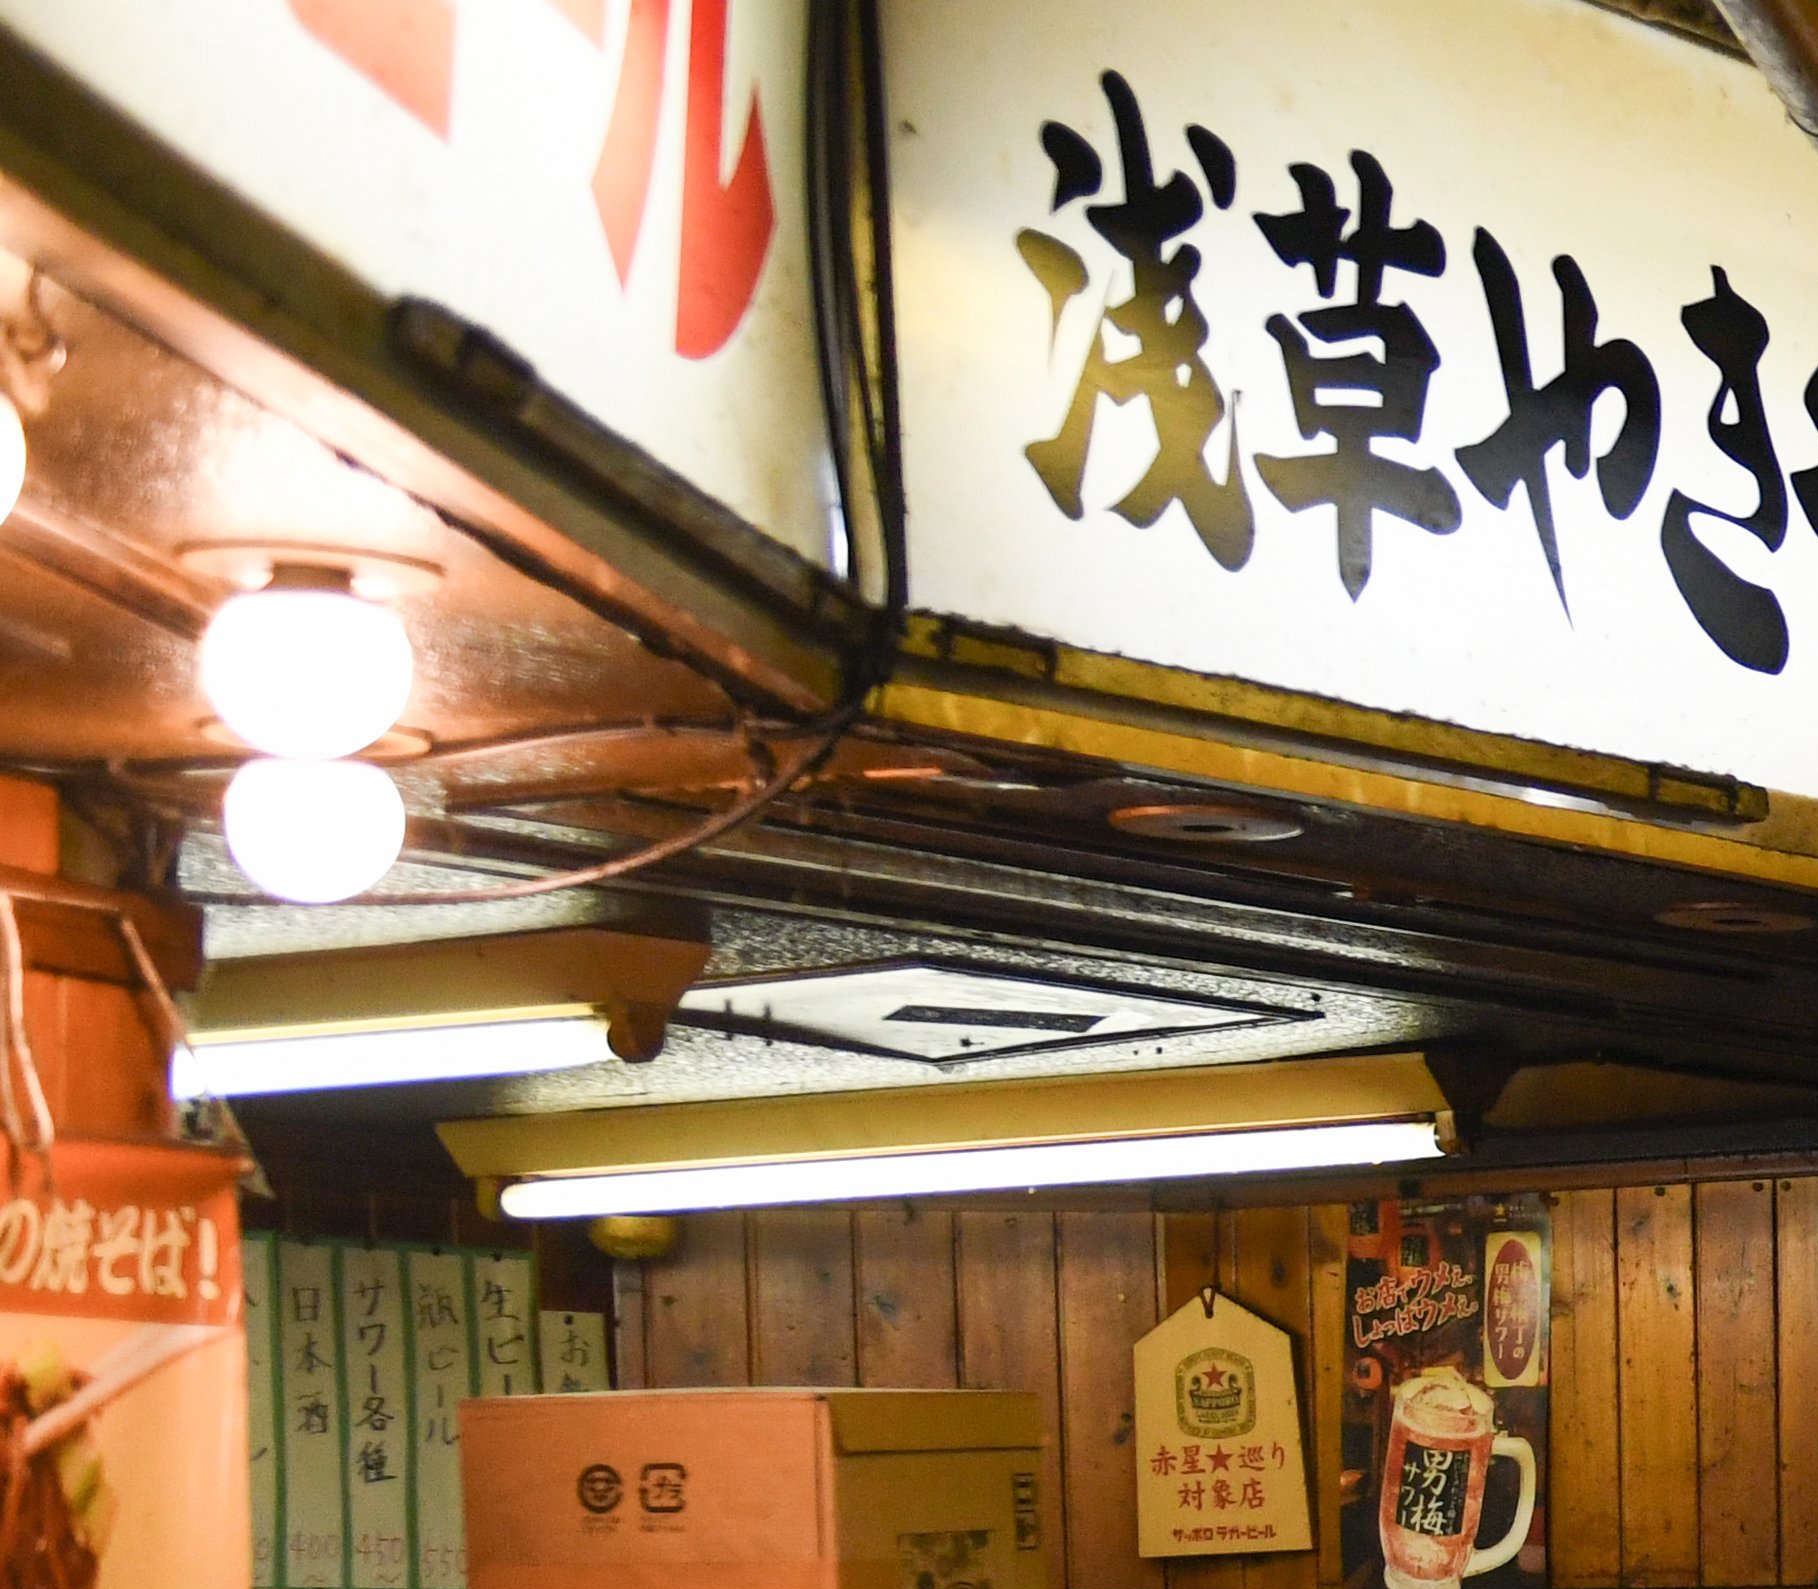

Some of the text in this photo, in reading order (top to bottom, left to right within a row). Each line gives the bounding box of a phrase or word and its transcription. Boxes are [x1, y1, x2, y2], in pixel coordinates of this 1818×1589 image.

[289, 1285, 332, 1435] 日本酒
[353, 1278, 398, 1484] サワー各種
[480, 1278, 524, 1397] 生ビー
[1177, 1478, 1266, 1511] 対象店
[1410, 1449, 1453, 1537] 男梅
